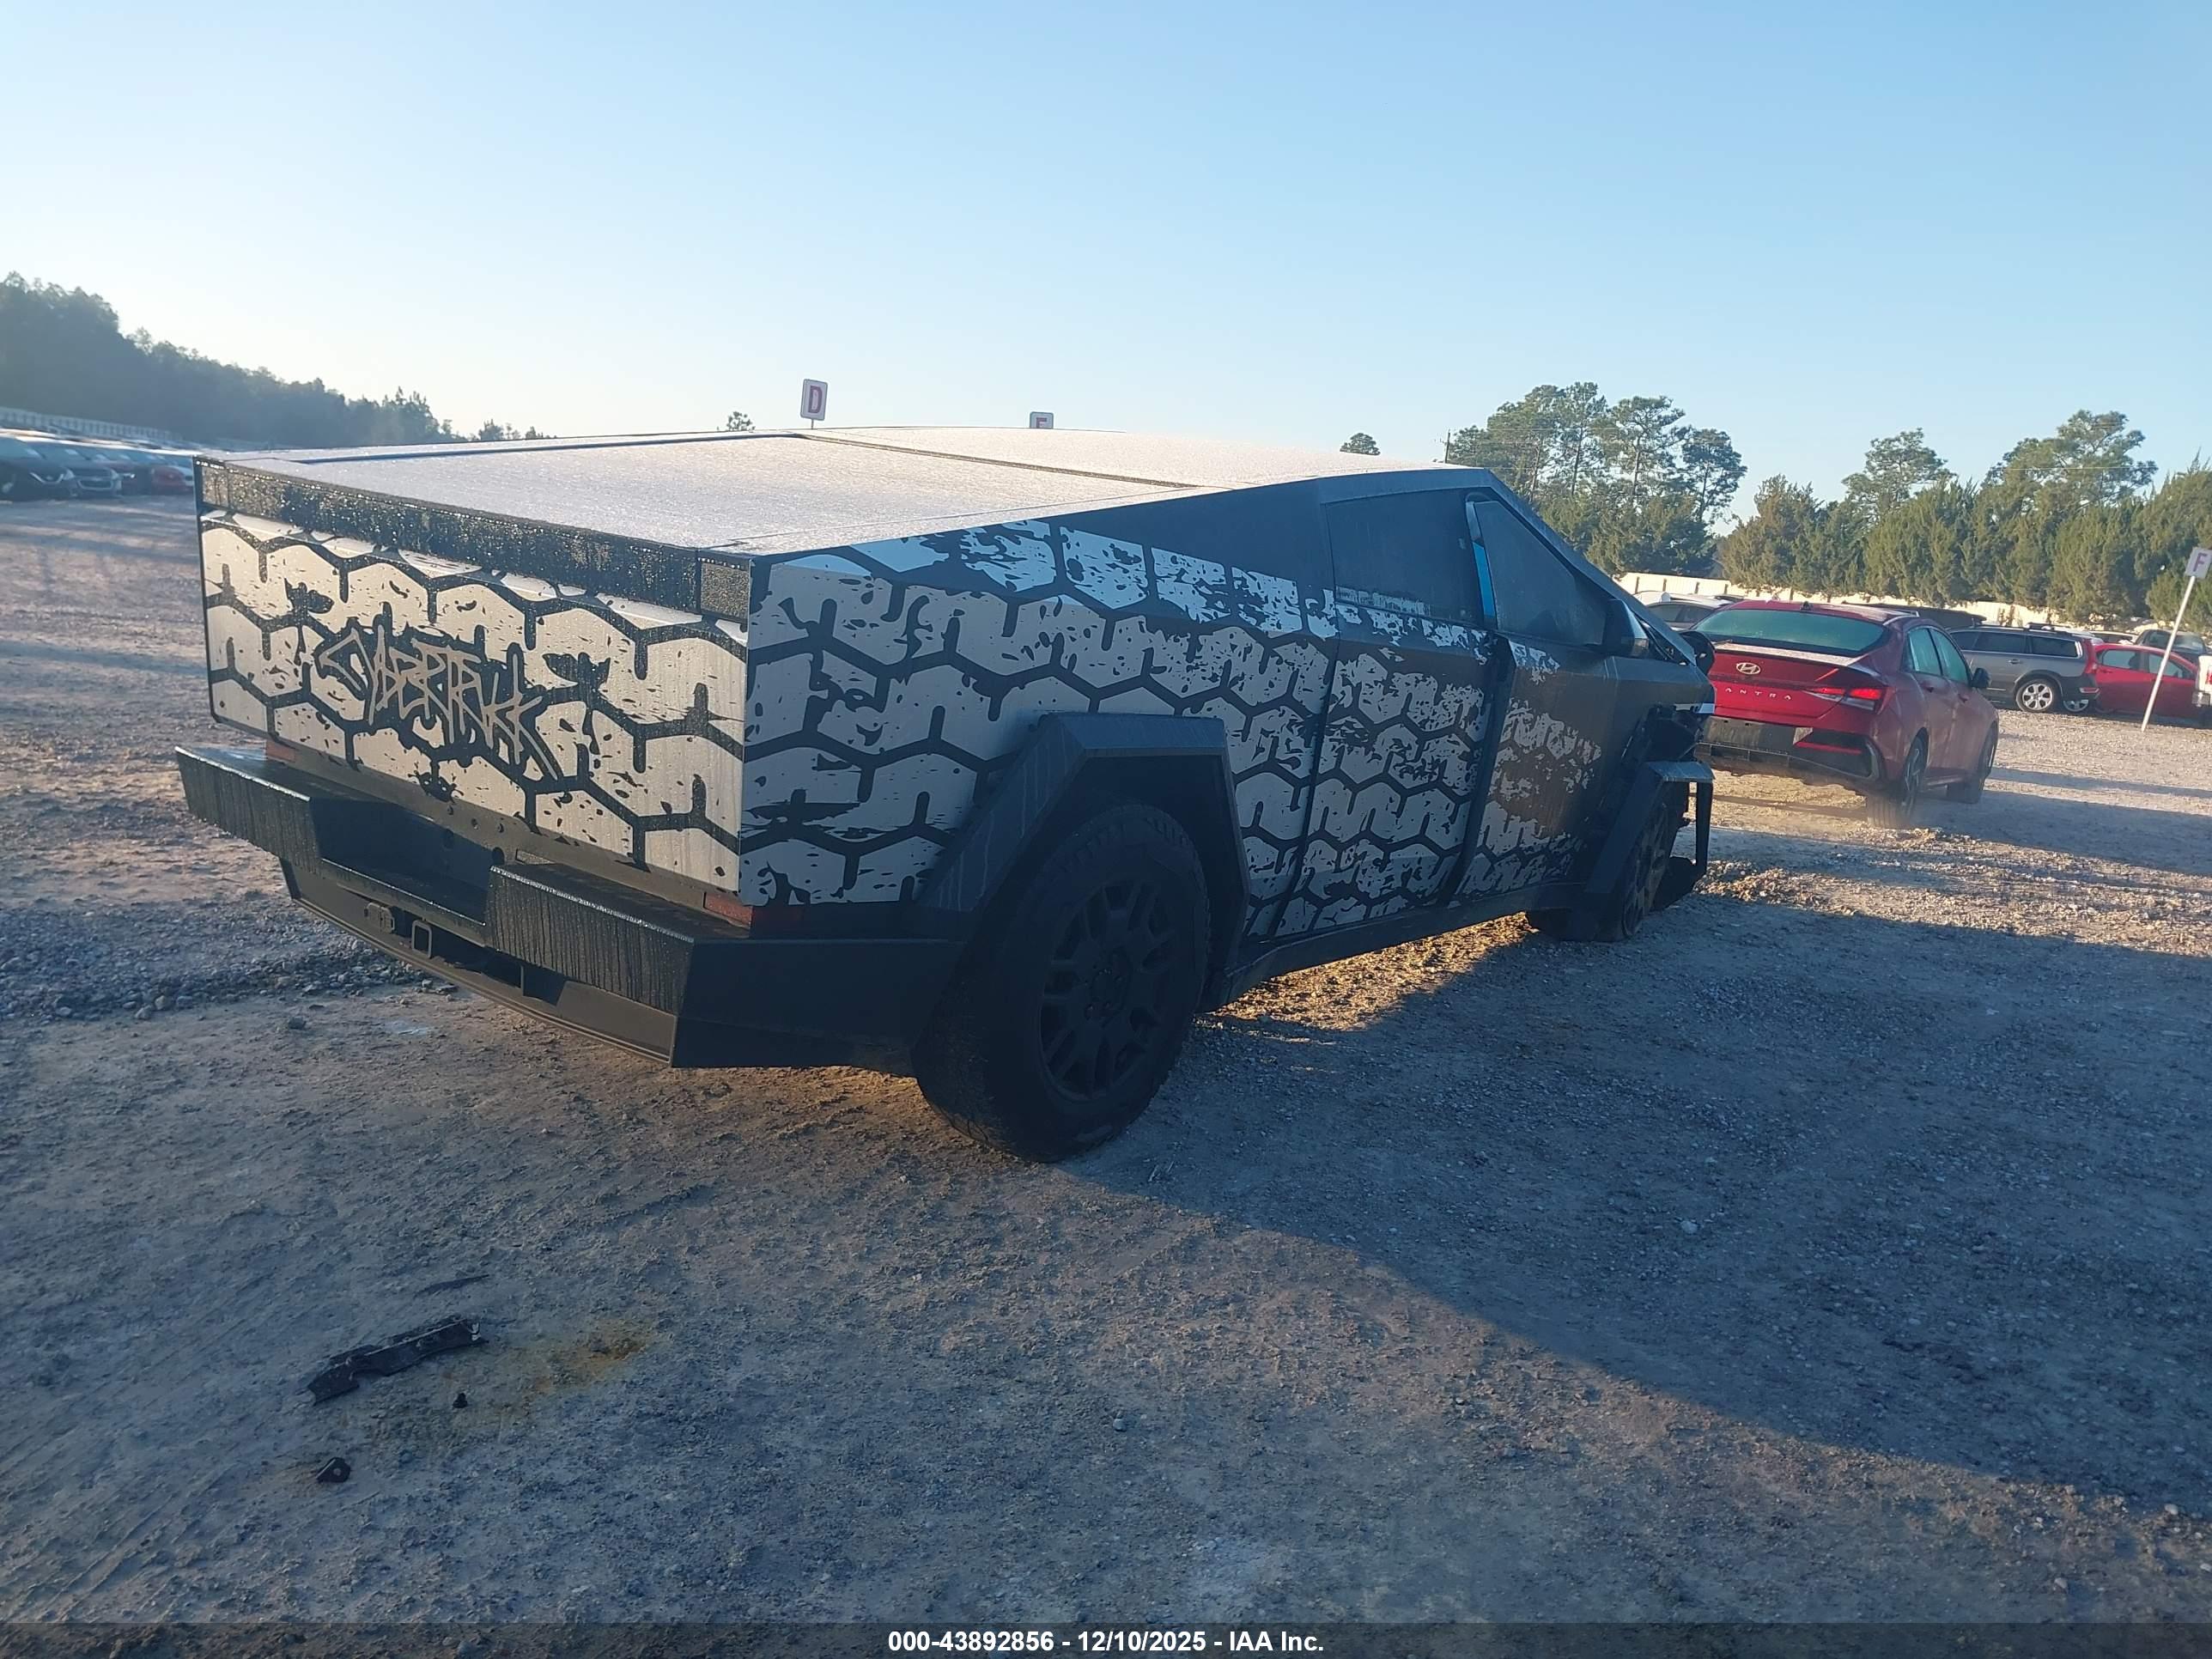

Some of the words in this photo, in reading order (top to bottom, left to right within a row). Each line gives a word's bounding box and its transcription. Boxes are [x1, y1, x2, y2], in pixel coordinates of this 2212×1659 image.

[808, 386, 823, 414] D
[2192, 552, 2208, 573] F
[1724, 687, 1792, 701] ANTRA
